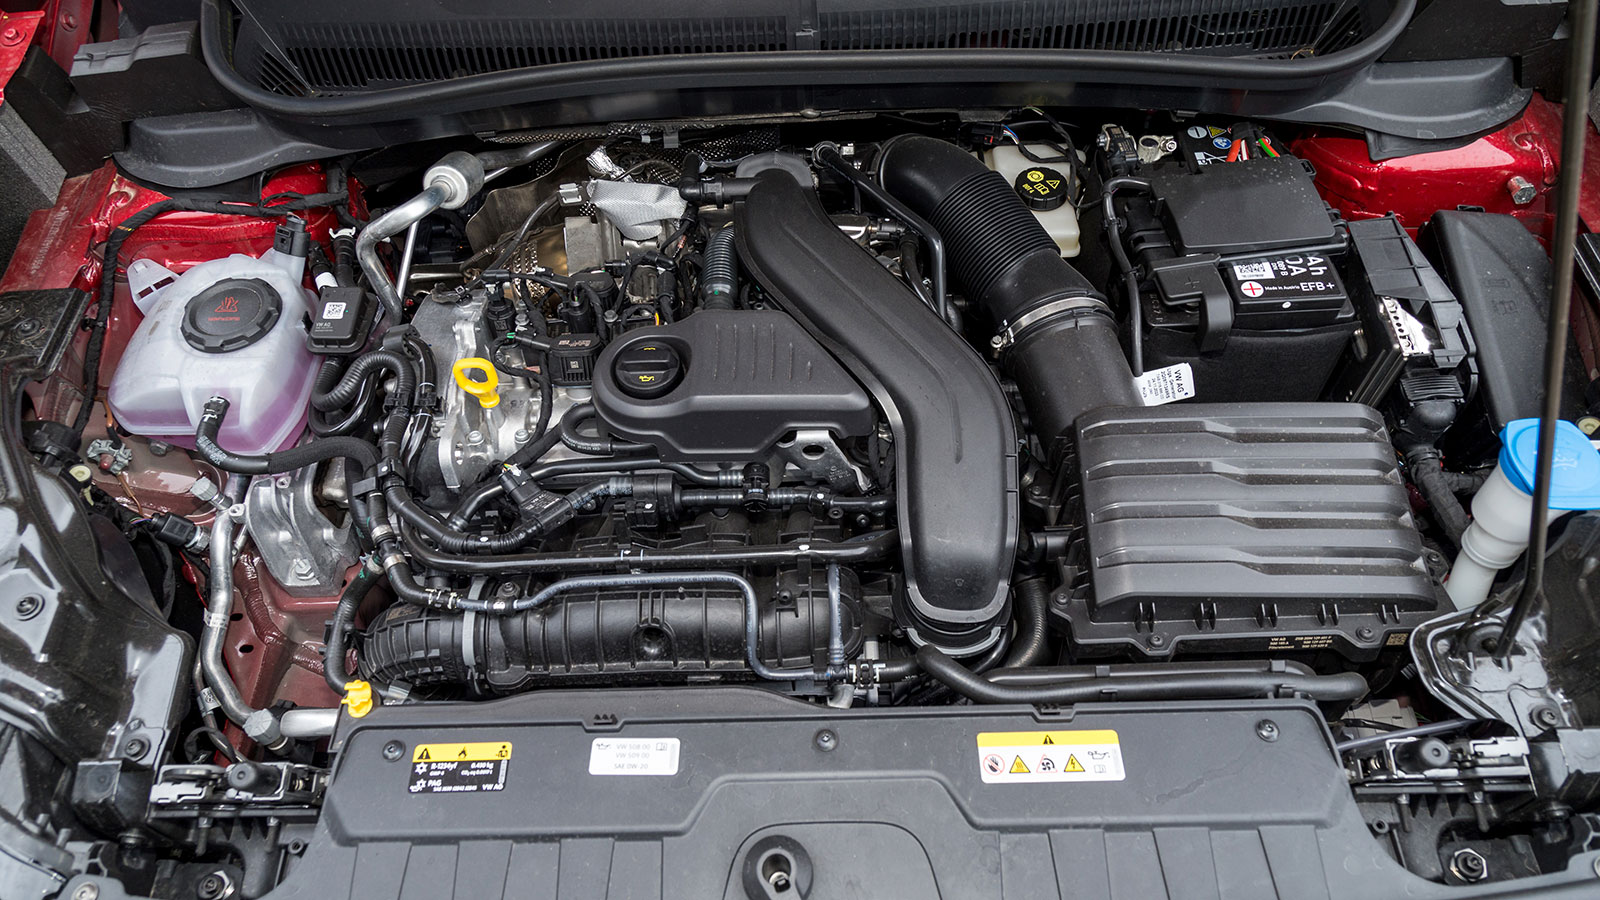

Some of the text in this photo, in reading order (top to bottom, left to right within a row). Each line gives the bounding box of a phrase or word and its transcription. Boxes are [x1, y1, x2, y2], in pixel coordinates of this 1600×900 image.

[1307, 256, 1328, 276] Ah
[1174, 369, 1185, 393] VW AG
[427, 779, 442, 787] PAG
